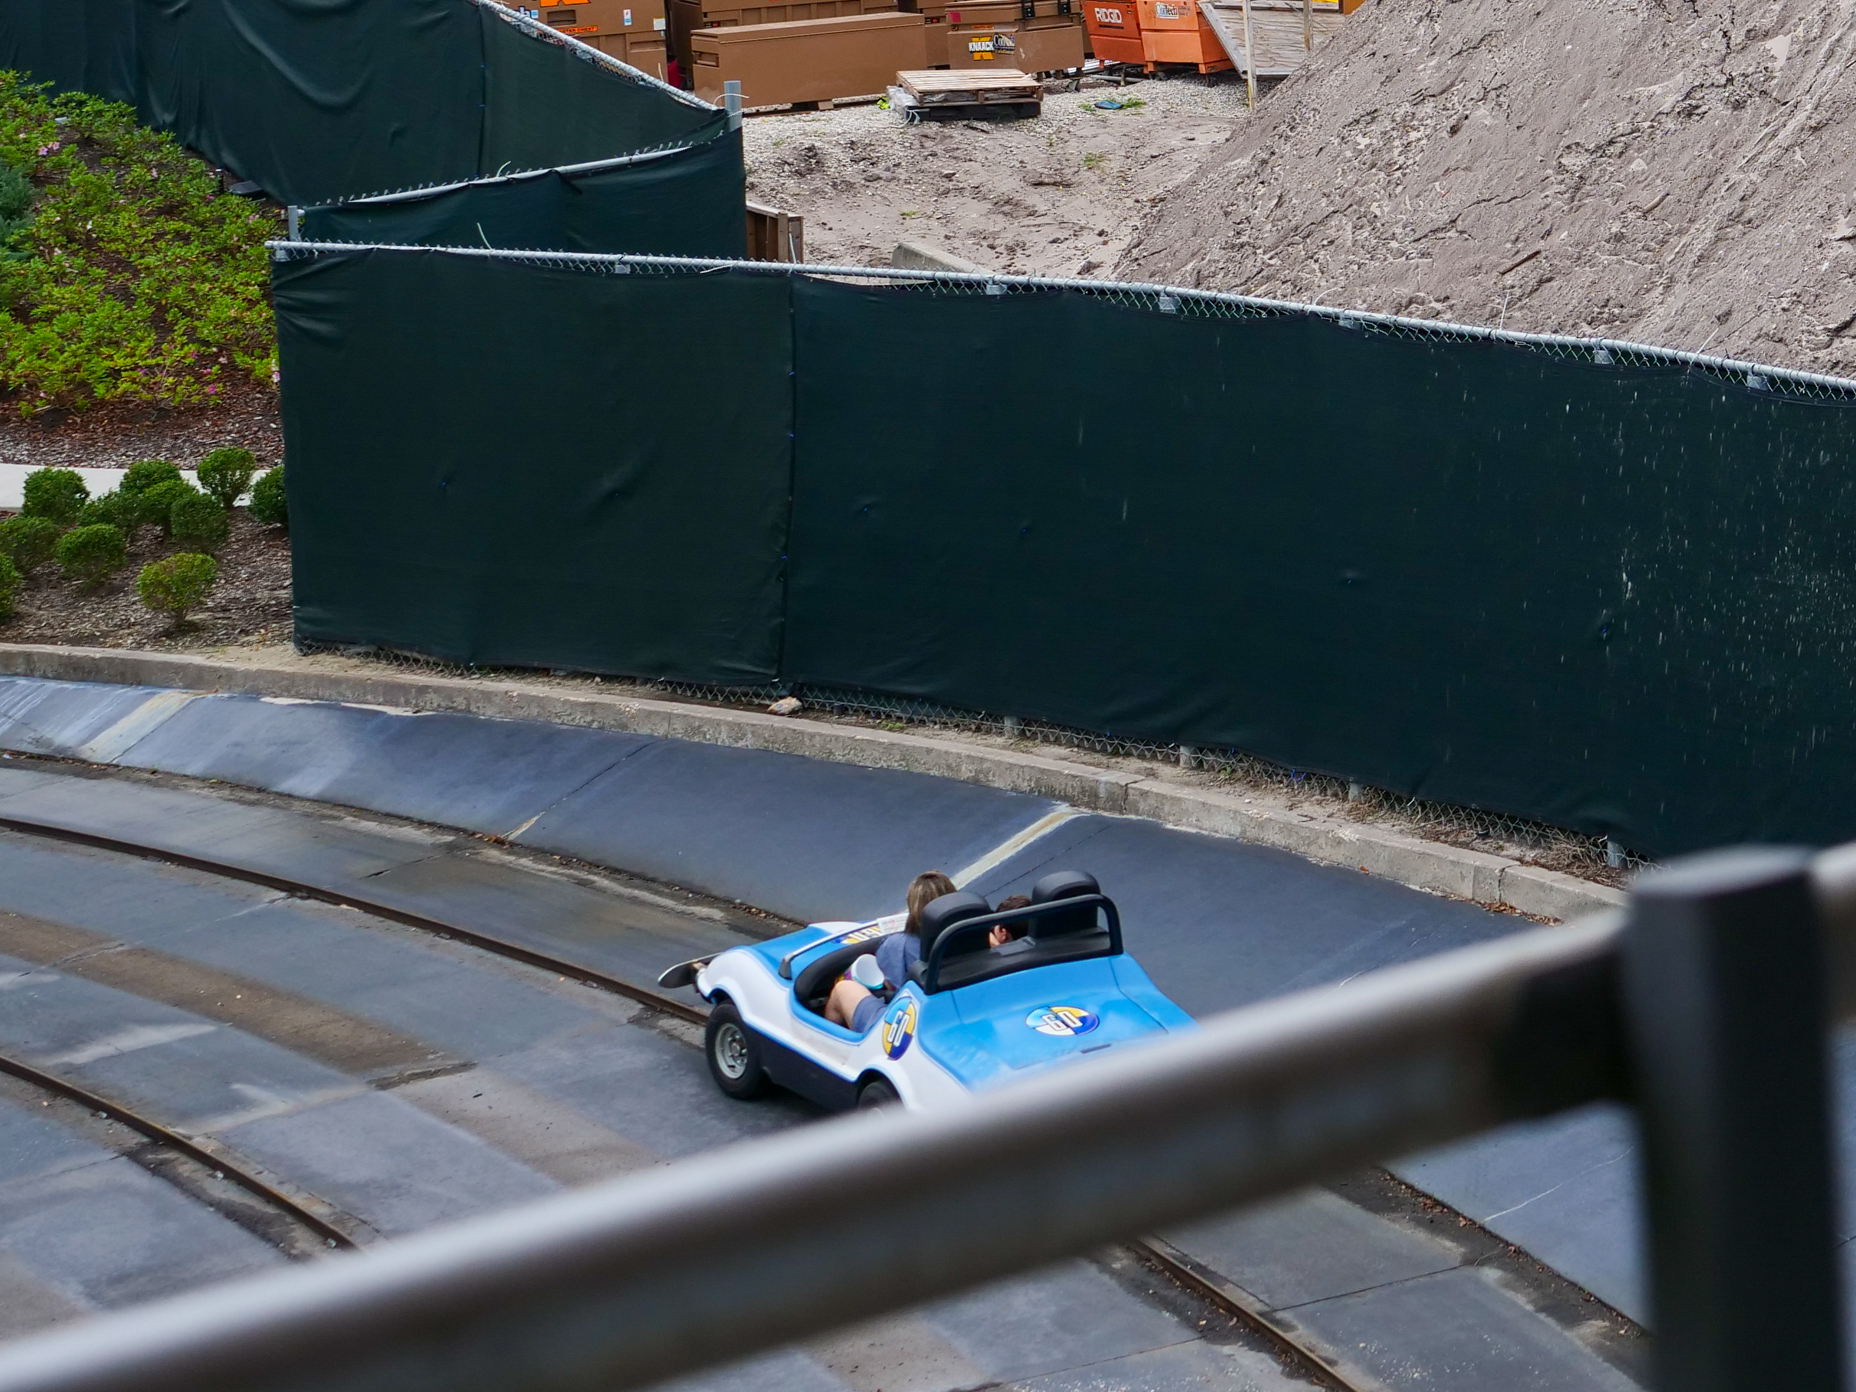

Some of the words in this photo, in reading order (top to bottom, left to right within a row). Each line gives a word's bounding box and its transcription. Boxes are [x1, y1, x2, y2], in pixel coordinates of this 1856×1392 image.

[968, 41, 995, 53] KNAACK
[887, 1009, 911, 1048] 60
[1041, 1010, 1084, 1031] 60
